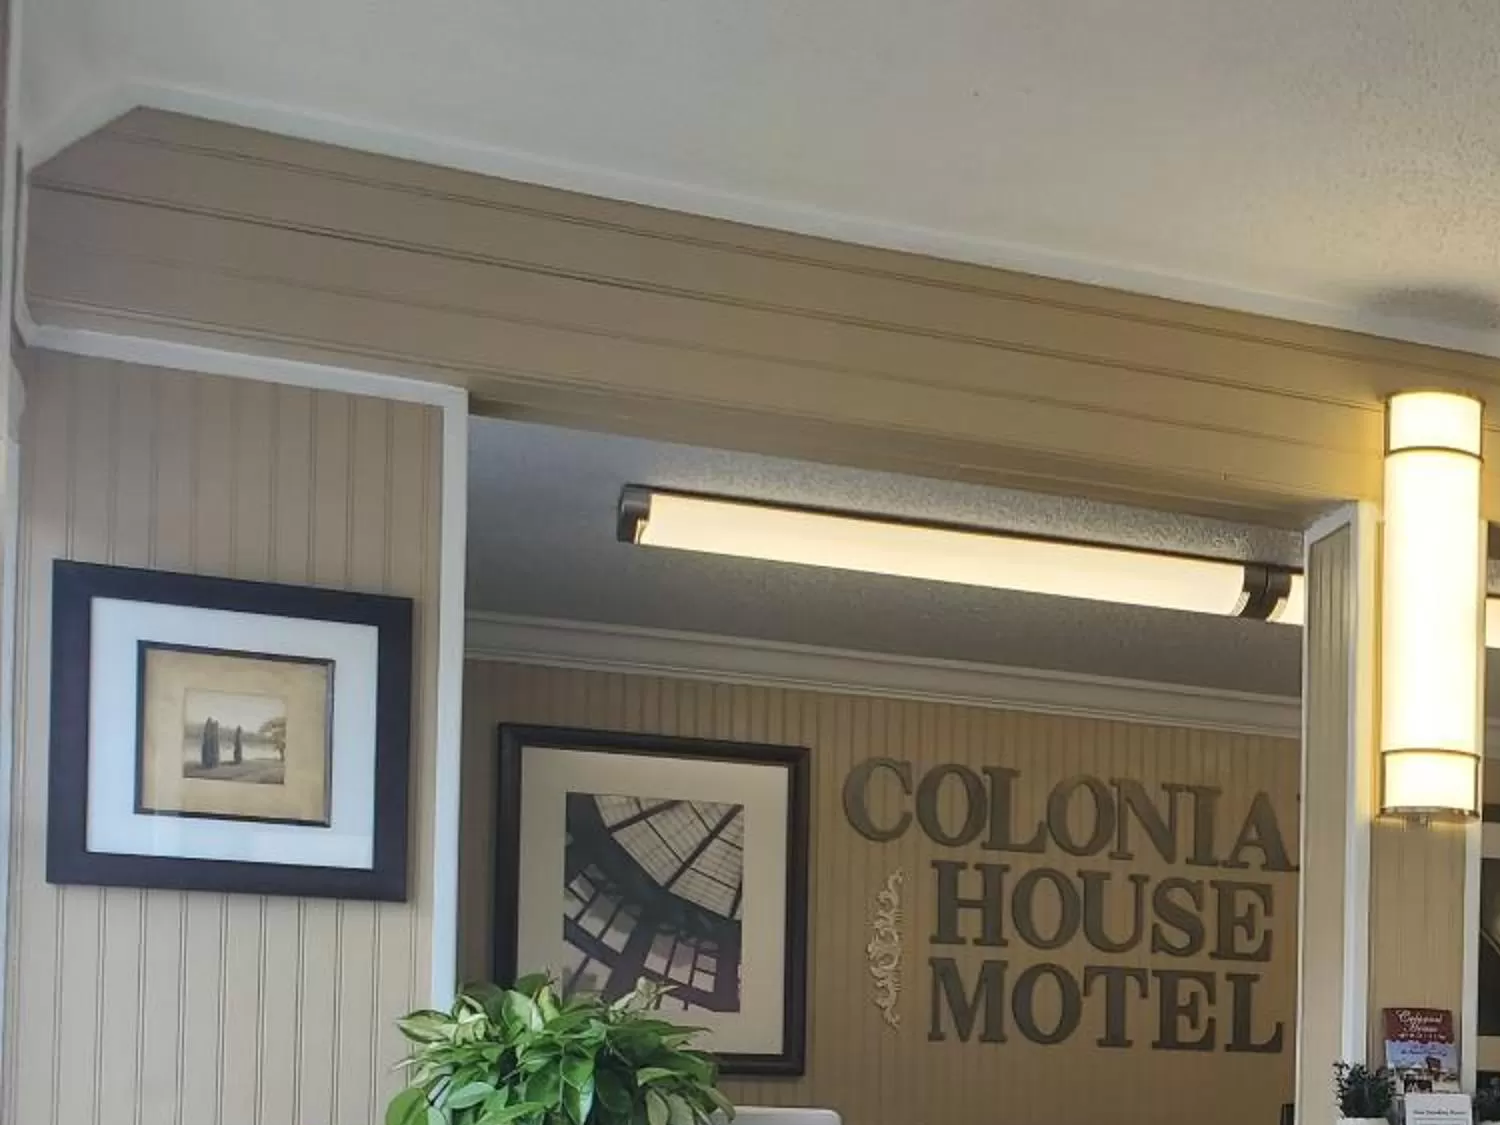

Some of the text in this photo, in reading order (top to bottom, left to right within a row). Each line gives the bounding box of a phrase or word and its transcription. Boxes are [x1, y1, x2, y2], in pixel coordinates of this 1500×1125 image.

[842, 757, 1300, 872] COLONIA
[929, 859, 1274, 963] HOUSE
[927, 957, 1285, 1054] MOTEL
